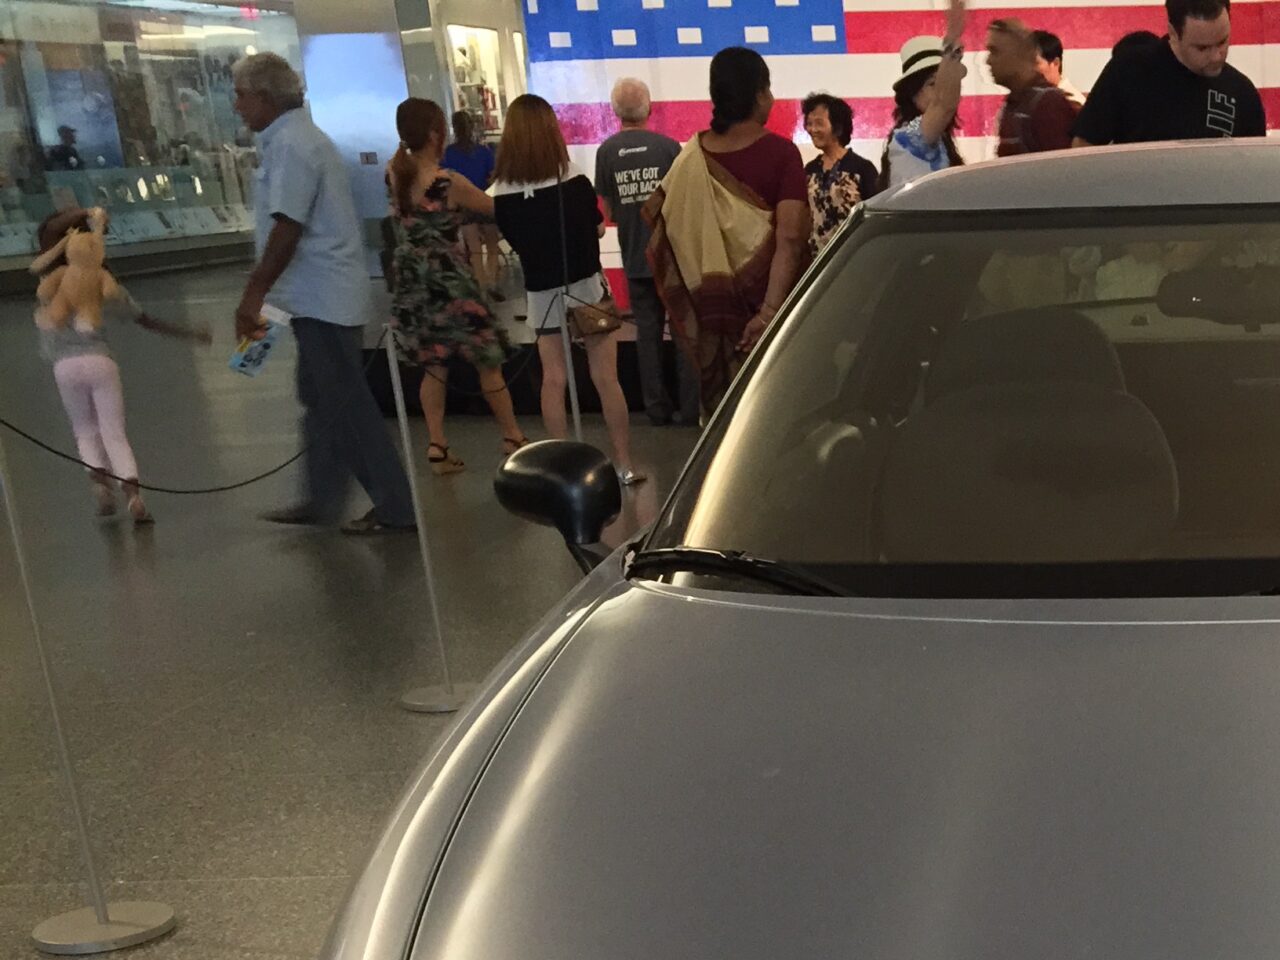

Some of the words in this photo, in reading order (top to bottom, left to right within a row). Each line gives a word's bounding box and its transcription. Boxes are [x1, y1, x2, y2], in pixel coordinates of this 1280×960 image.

[614, 168, 641, 184] WE'VE
[642, 167, 660, 180] GOT
[617, 184, 639, 197] YOUR
